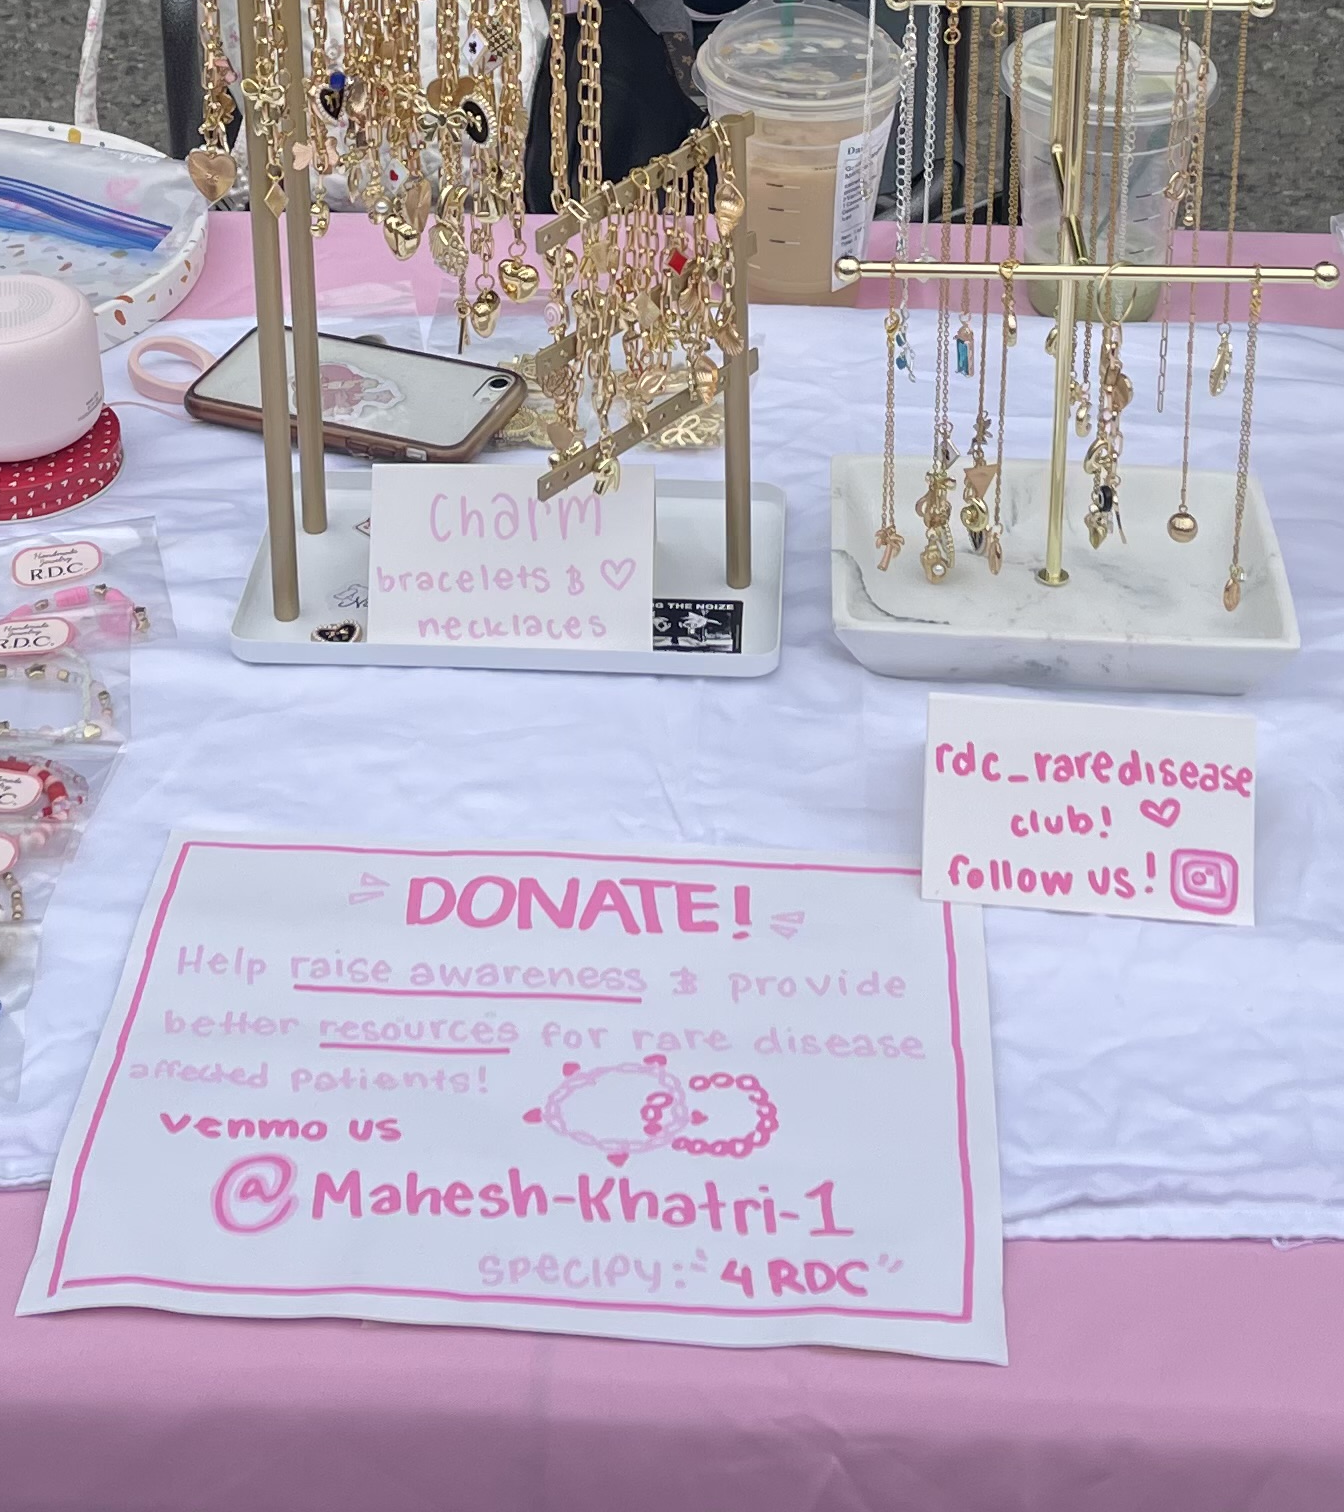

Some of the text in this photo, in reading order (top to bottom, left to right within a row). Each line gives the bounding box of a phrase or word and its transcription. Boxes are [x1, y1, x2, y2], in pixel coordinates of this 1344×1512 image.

[430, 492, 603, 542] Charm
[376, 564, 551, 593] bracelets
[667, 602, 693, 610] THE
[696, 603, 735, 611] NOIZE
[418, 614, 607, 641] necklaces
[935, 741, 1254, 798] rdc_raredisease
[1010, 804, 1112, 839] club!
[948, 851, 1156, 899] follow us!
[406, 876, 750, 940] DONATE!
[177, 945, 268, 984] Help
[292, 950, 394, 985] raise
[410, 955, 644, 994] awareness
[730, 969, 906, 1002] provide
[164, 1010, 924, 1060] better resources for rare disease
[129, 1061, 486, 1093] affected patients!
[349, 1118, 402, 1141] us
